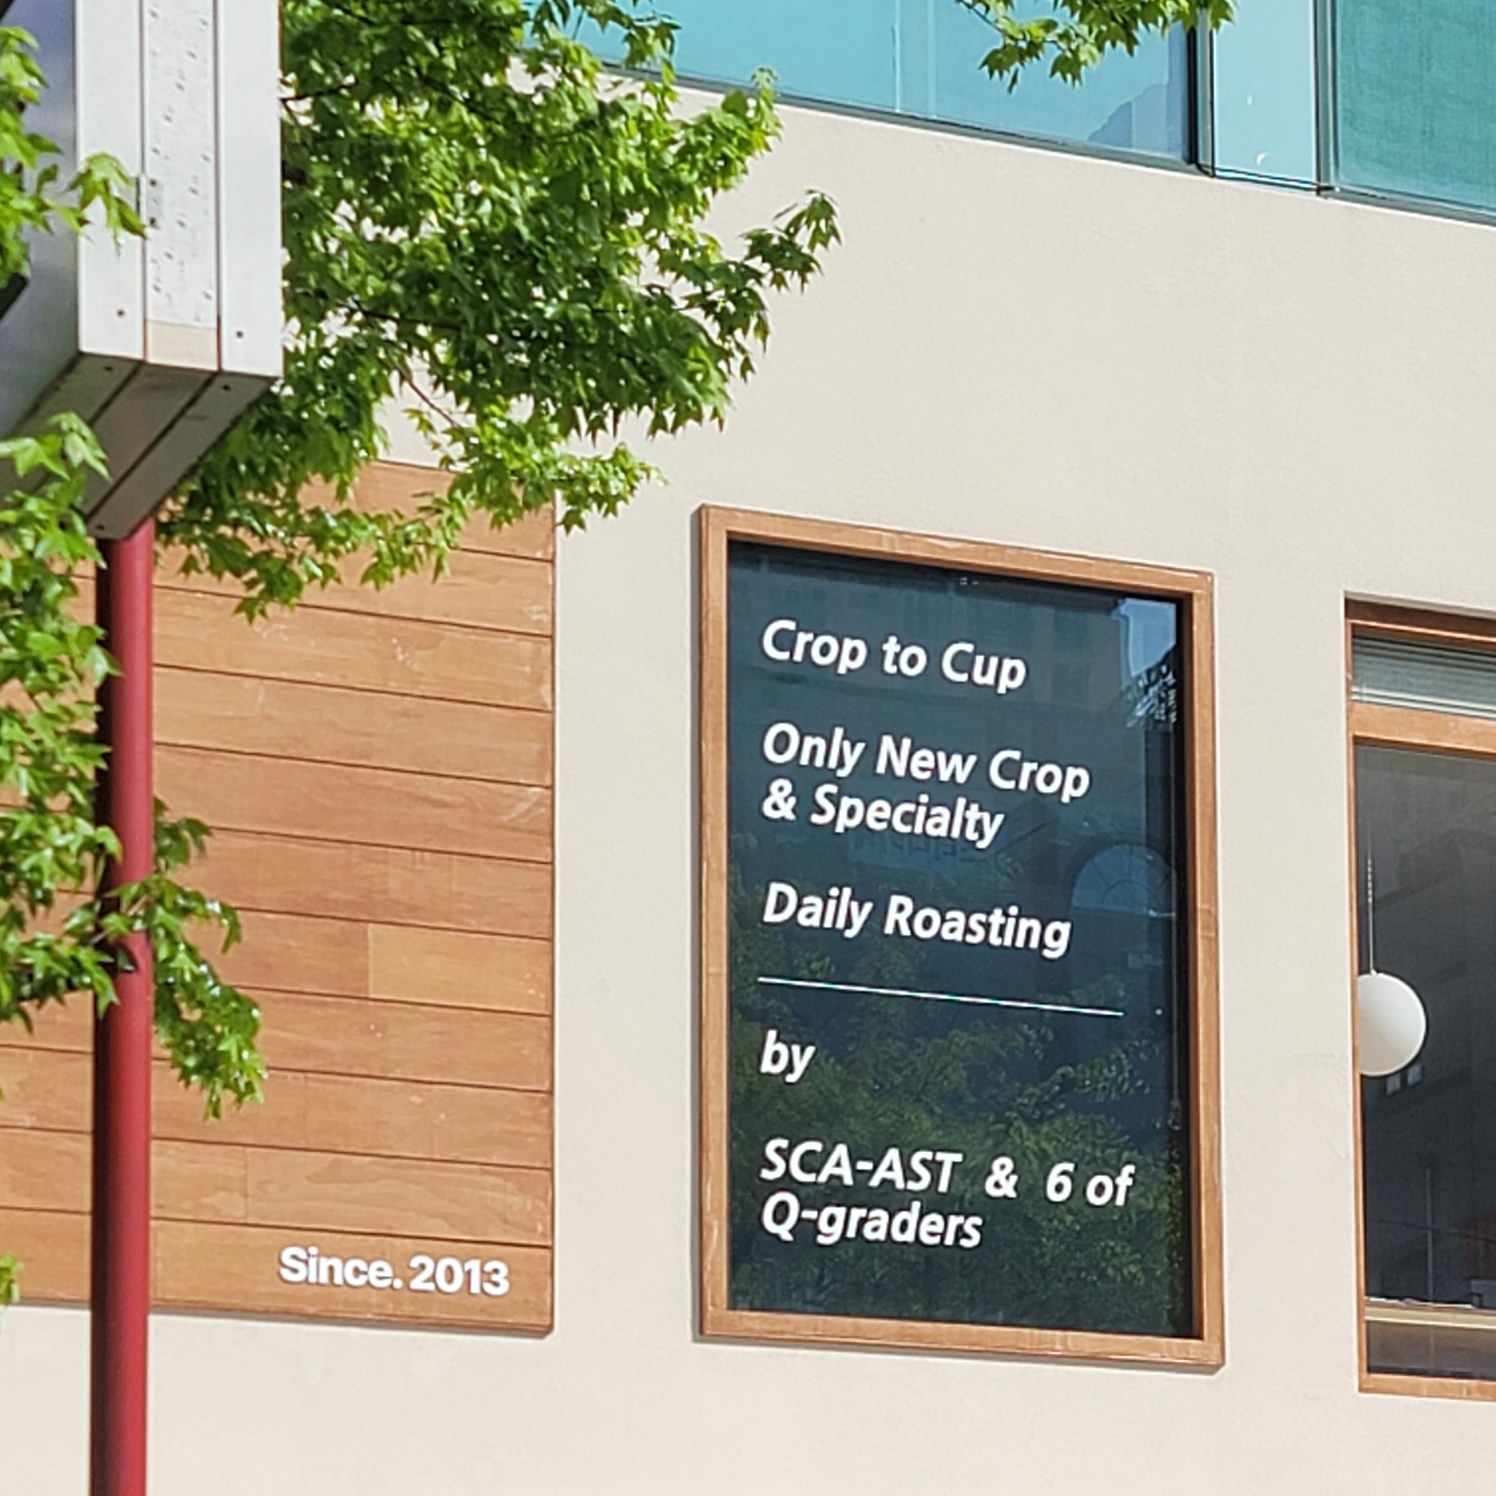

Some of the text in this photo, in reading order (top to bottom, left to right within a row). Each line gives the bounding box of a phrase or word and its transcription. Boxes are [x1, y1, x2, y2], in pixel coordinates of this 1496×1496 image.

[762, 618, 1027, 693] Crop to Cup
[763, 723, 1090, 802] Only New Crop
[762, 778, 1003, 849] & Specialty
[763, 882, 1072, 958] Daily Roasting
[760, 1029, 815, 1082] by
[761, 1138, 1135, 1207] SCA-AST & 6 of
[761, 1191, 983, 1249] Q-graders
[279, 1246, 510, 1296] Since. 2013
